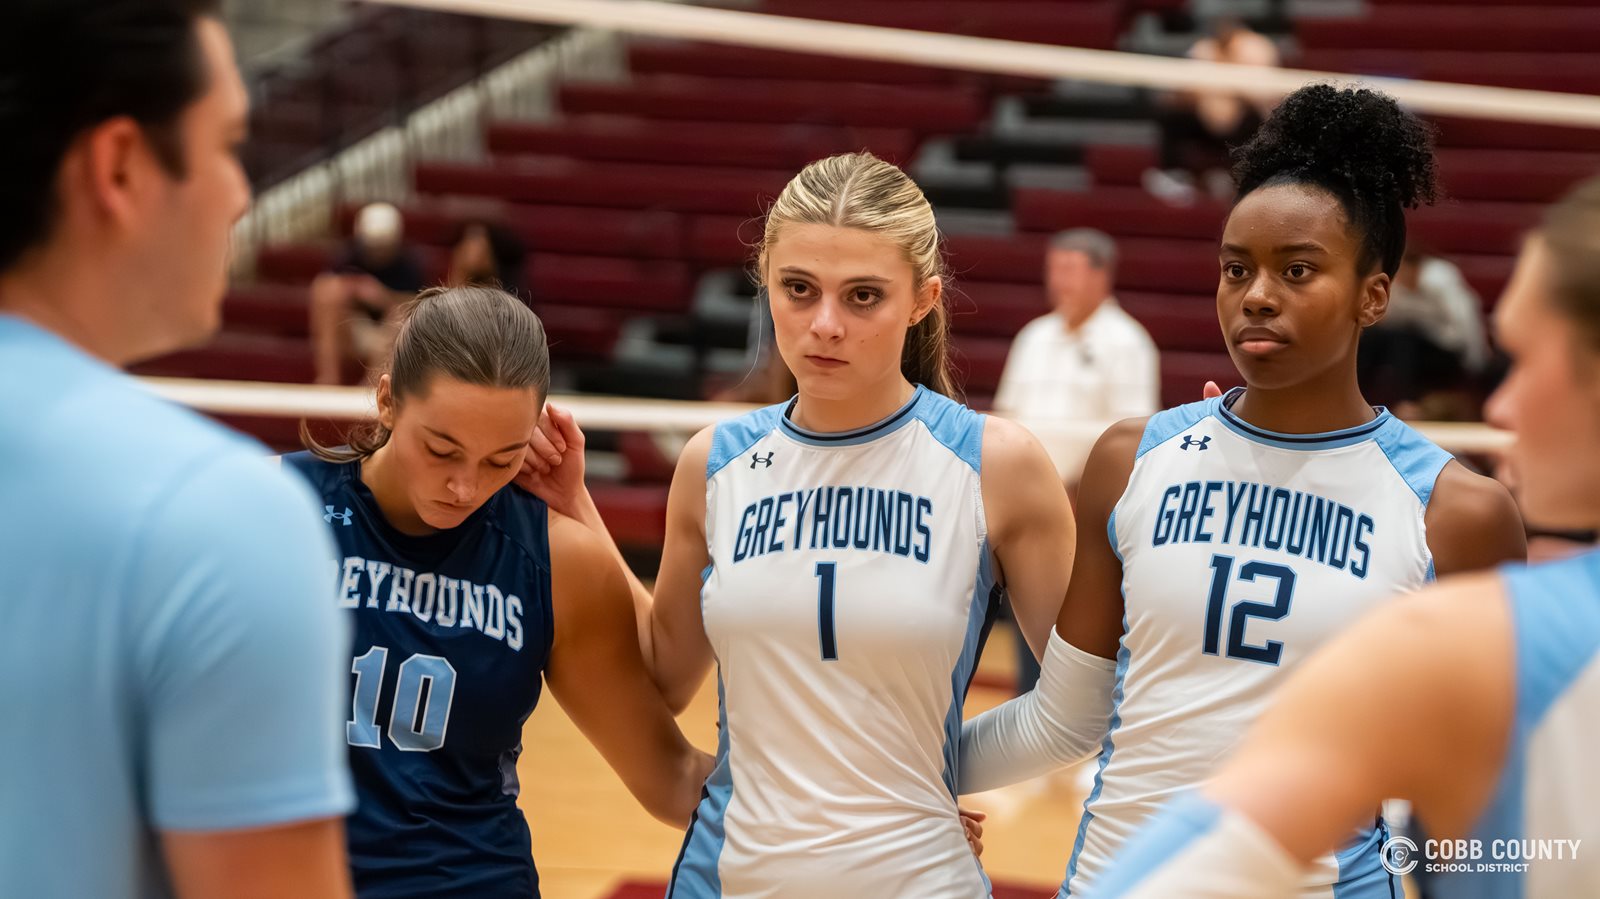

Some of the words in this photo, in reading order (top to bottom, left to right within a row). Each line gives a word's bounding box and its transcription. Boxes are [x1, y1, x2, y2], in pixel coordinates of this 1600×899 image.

[733, 485, 933, 564] GREYHOUNDS
[1152, 480, 1375, 580] GREYHOUNDS
[814, 561, 838, 661] 1
[1202, 553, 1297, 667] 12
[346, 645, 457, 752] 10
